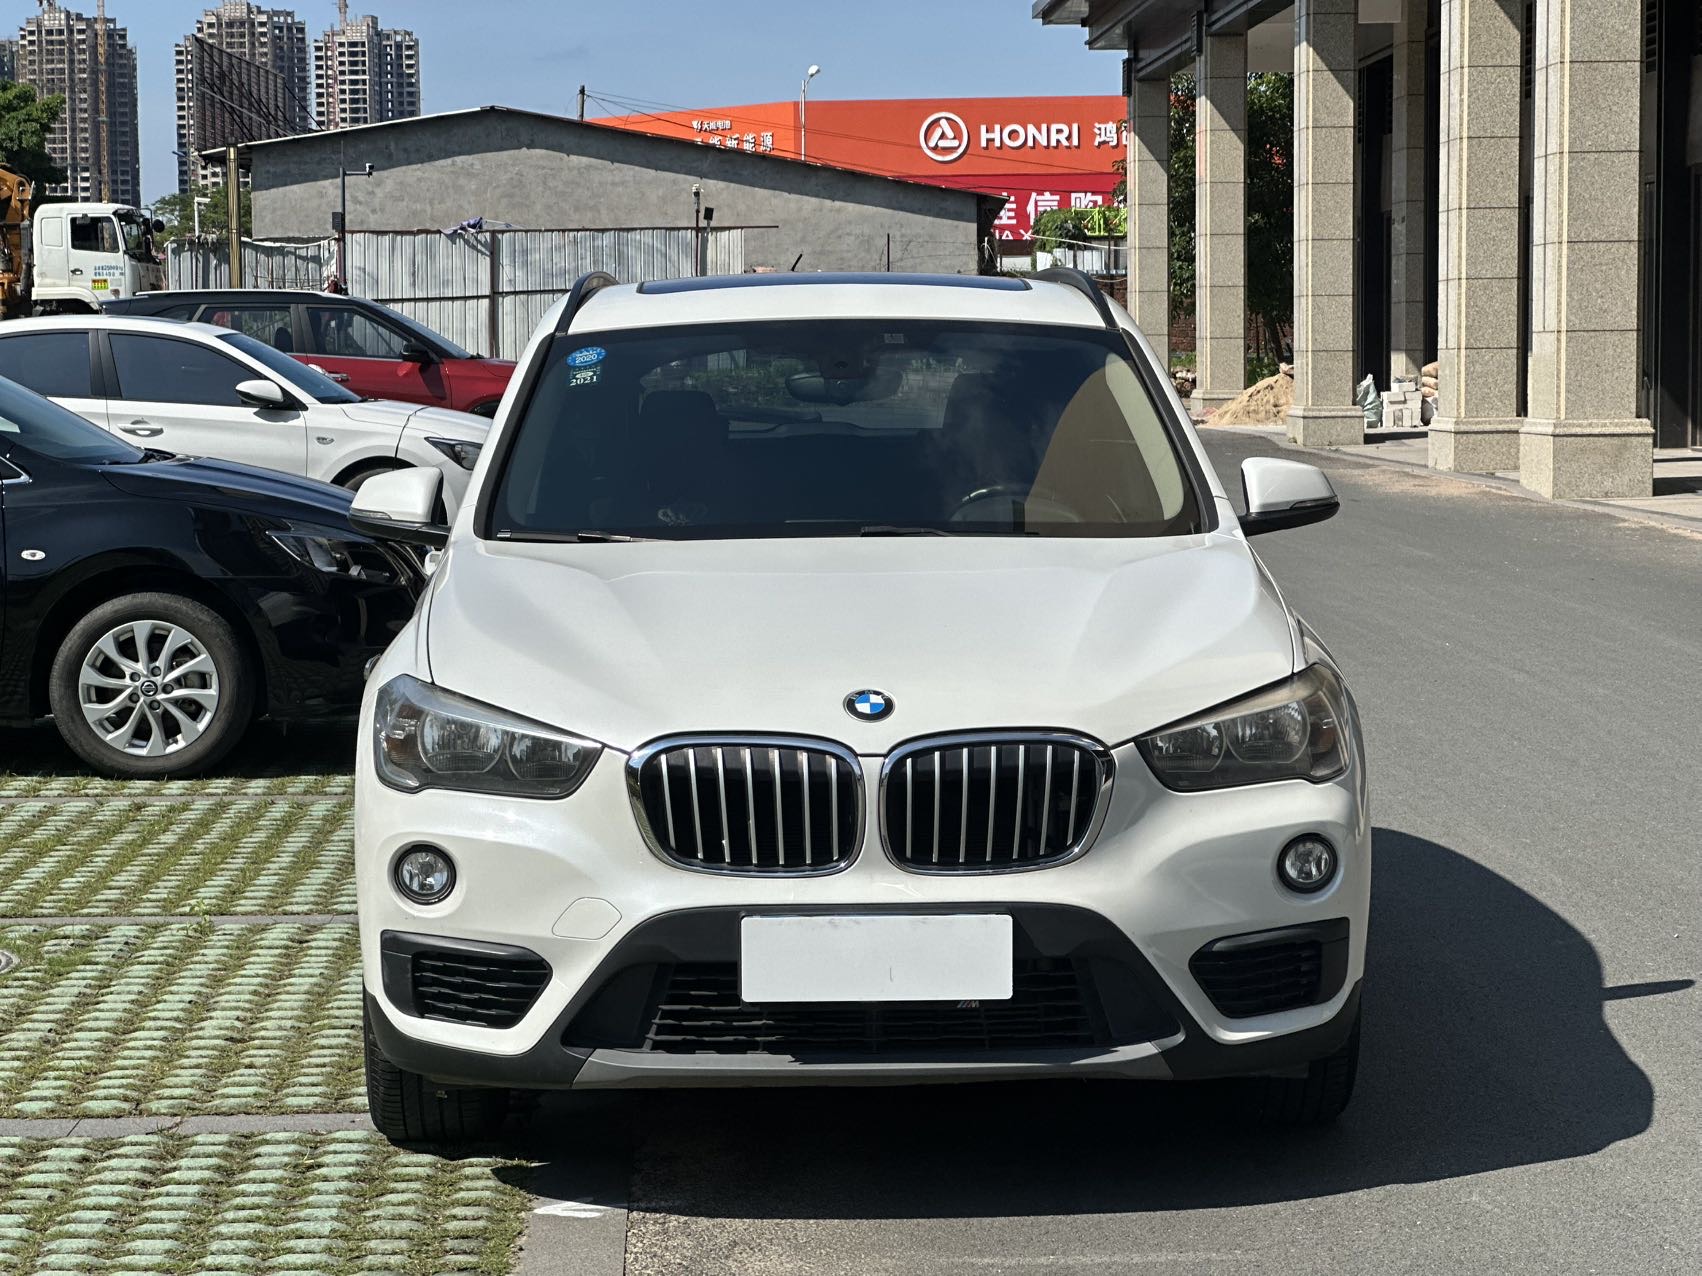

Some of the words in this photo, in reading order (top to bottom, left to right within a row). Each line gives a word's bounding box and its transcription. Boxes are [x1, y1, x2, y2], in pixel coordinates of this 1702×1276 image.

[980, 123, 1079, 147] HONRI
[1093, 121, 1127, 146] 鸿
[695, 132, 773, 153] 能新能源
[576, 353, 598, 363] 2020
[570, 376, 597, 386] 2021
